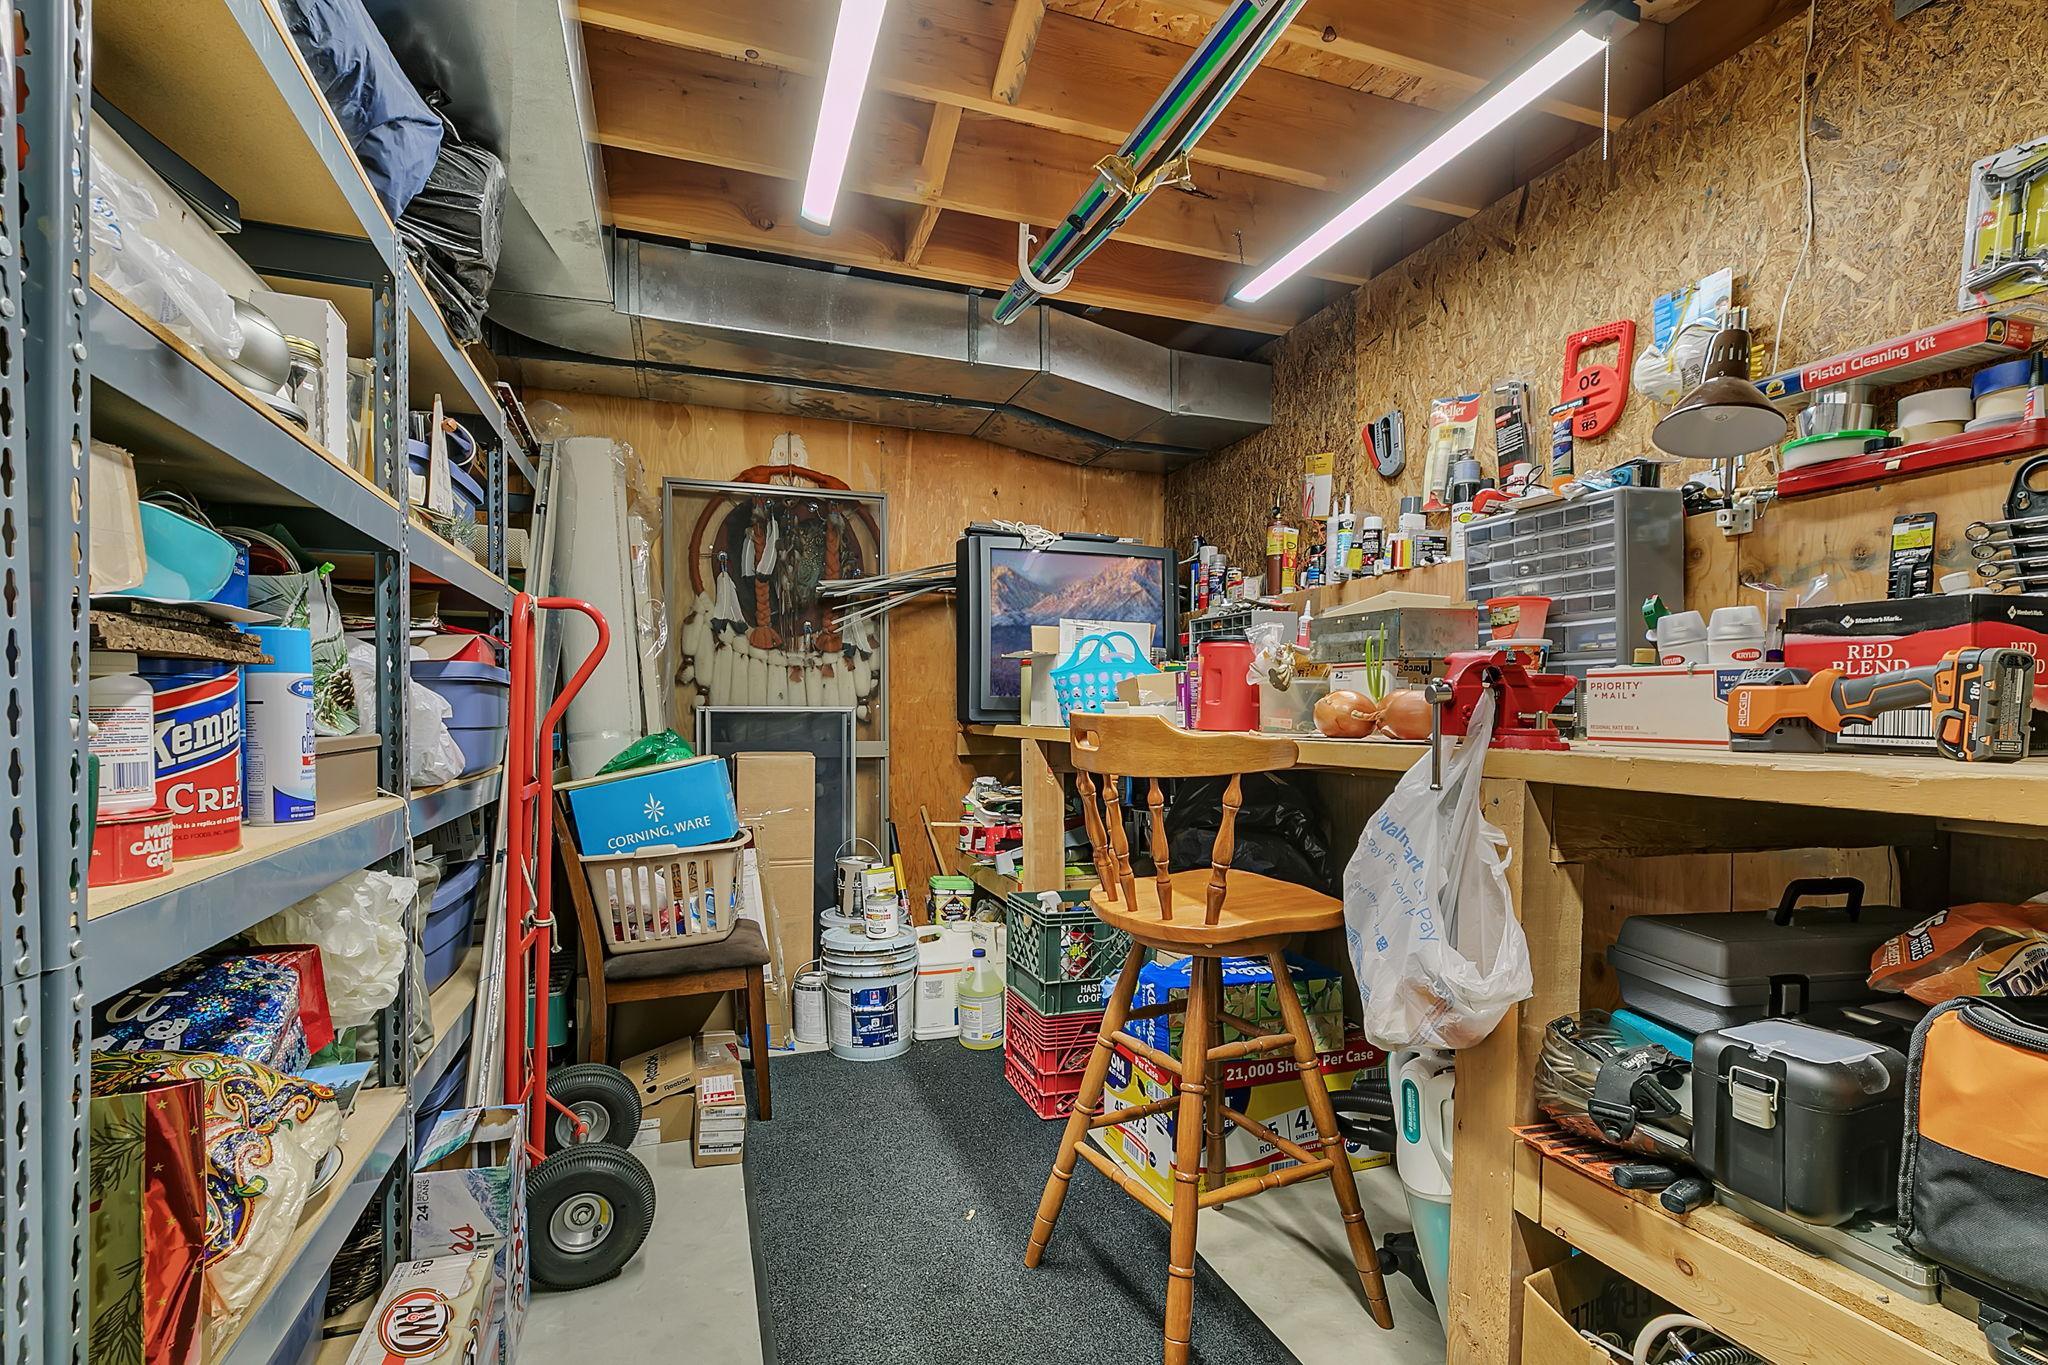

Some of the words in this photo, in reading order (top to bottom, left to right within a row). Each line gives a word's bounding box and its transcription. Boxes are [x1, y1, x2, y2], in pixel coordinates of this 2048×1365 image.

[1808, 362, 1847, 382] Pistol
[1850, 345, 1910, 371] Cleaning
[1915, 335, 1937, 353] Kit
[1736, 651, 1760, 659] KRYLON
[1847, 643, 1893, 659] RED
[1590, 681, 1639, 691] PRIORITY
[1738, 690, 1749, 727] RIDGID
[607, 825, 671, 850] CORNING
[674, 815, 712, 834] WARE
[1416, 906, 1439, 941] Pay
[1910, 938, 1923, 962] ROLLS
[1919, 933, 1934, 957] MEGA
[1144, 1062, 1159, 1081] Case
[1226, 1064, 1274, 1082] 21,000
[1322, 1053, 1344, 1067] Per
[1345, 1049, 1374, 1064] Case
[422, 1179, 430, 1202] CANS
[416, 1204, 429, 1222] 24
[394, 1304, 441, 1338] A&W
